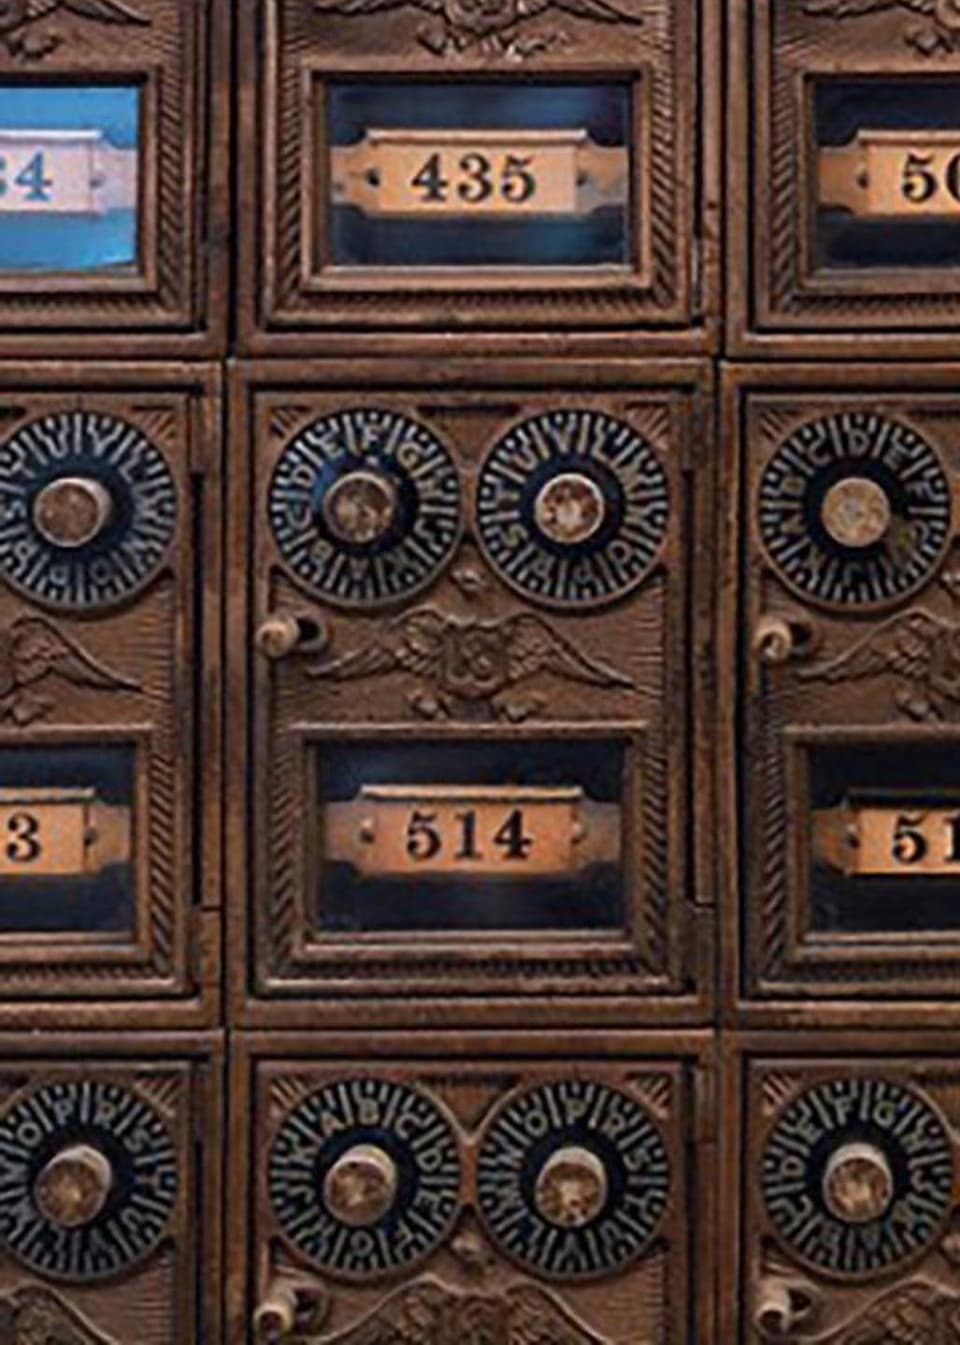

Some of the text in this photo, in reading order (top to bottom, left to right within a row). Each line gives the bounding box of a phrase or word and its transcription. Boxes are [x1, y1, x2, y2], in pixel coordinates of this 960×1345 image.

[0, 152, 52, 201] 4
[411, 152, 536, 204] 435
[6, 811, 41, 862] 3
[406, 808, 533, 862] 514
